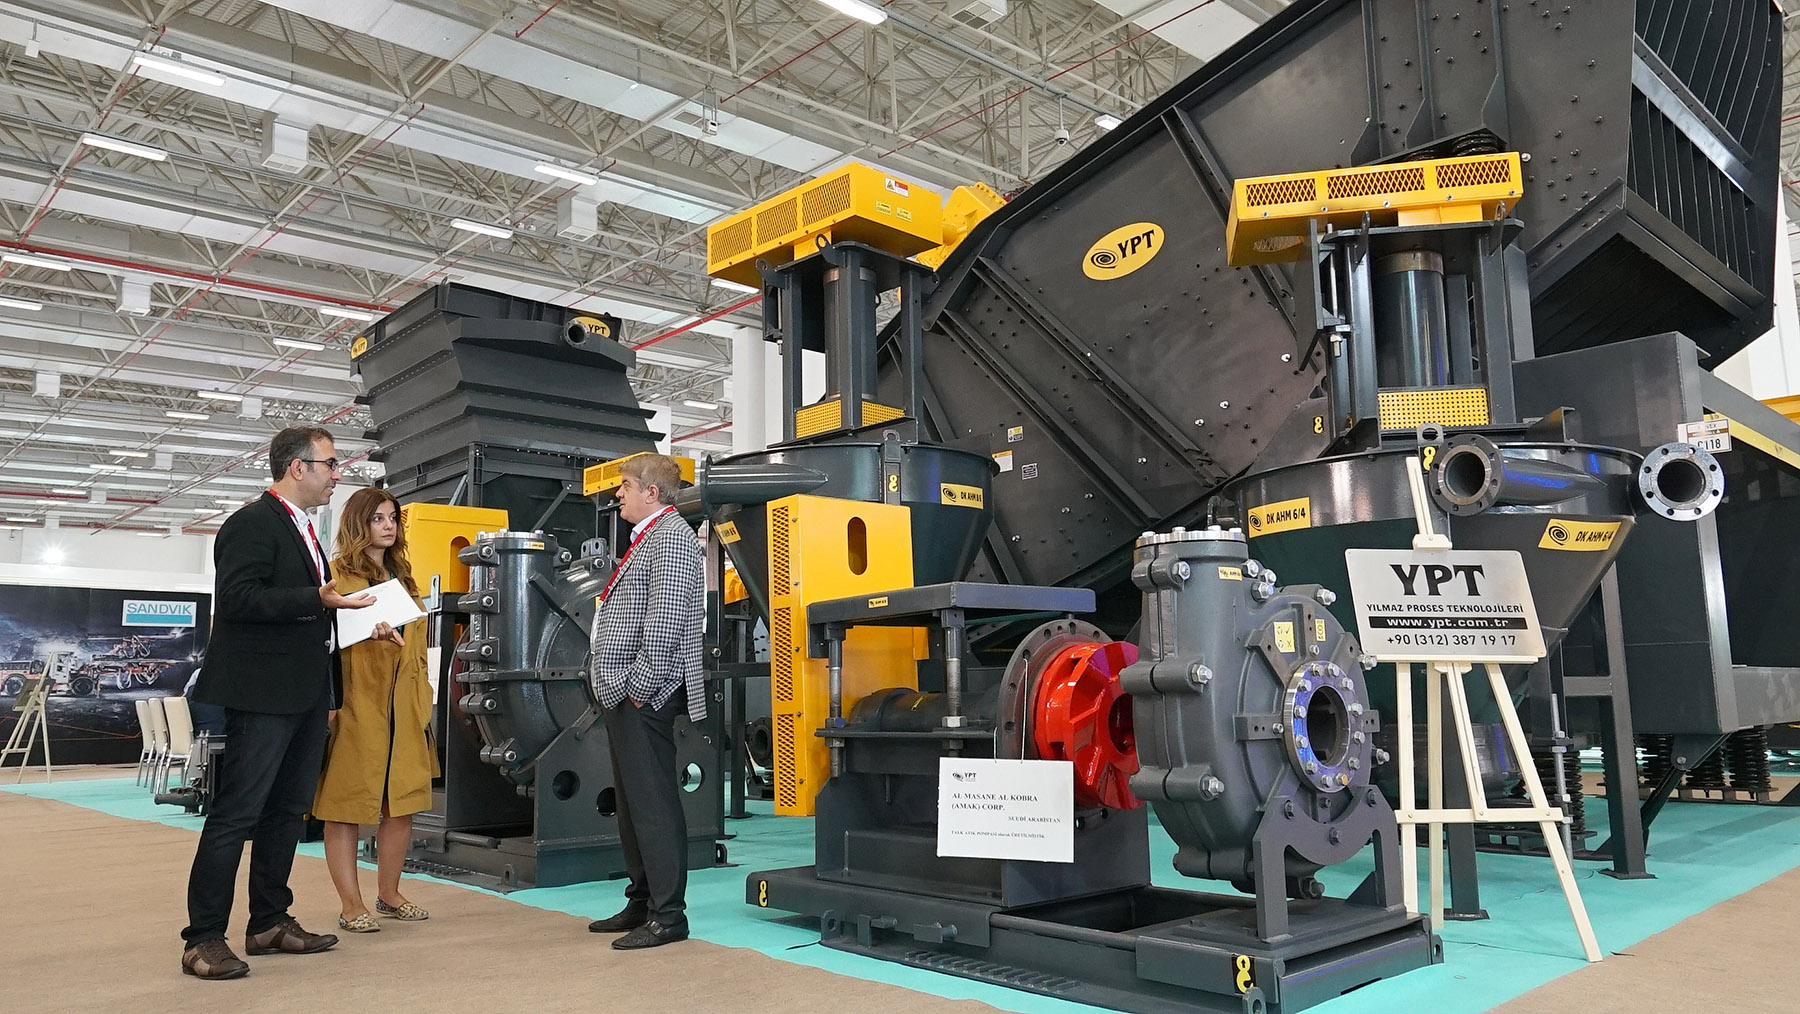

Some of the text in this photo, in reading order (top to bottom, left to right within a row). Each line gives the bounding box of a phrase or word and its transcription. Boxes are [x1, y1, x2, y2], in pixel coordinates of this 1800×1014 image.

[1117, 229, 1155, 259] YPT
[588, 324, 606, 335] YPT
[1266, 507, 1306, 524] DK AHM 6/4
[1575, 531, 1588, 541] DK
[1389, 564, 1486, 597] YPT
[127, 603, 191, 614] SANDVIK
[1366, 602, 1524, 613] YILMAZ PROSES TEKNOLOJİLERİ
[1386, 618, 1509, 629] www.ypt.com.tr
[1387, 634, 1517, 646] +90 (312) 387 19 17
[964, 793, 997, 801] MASANE
[1010, 794, 1038, 802] KOBRA
[951, 803, 981, 811] (AMAK)
